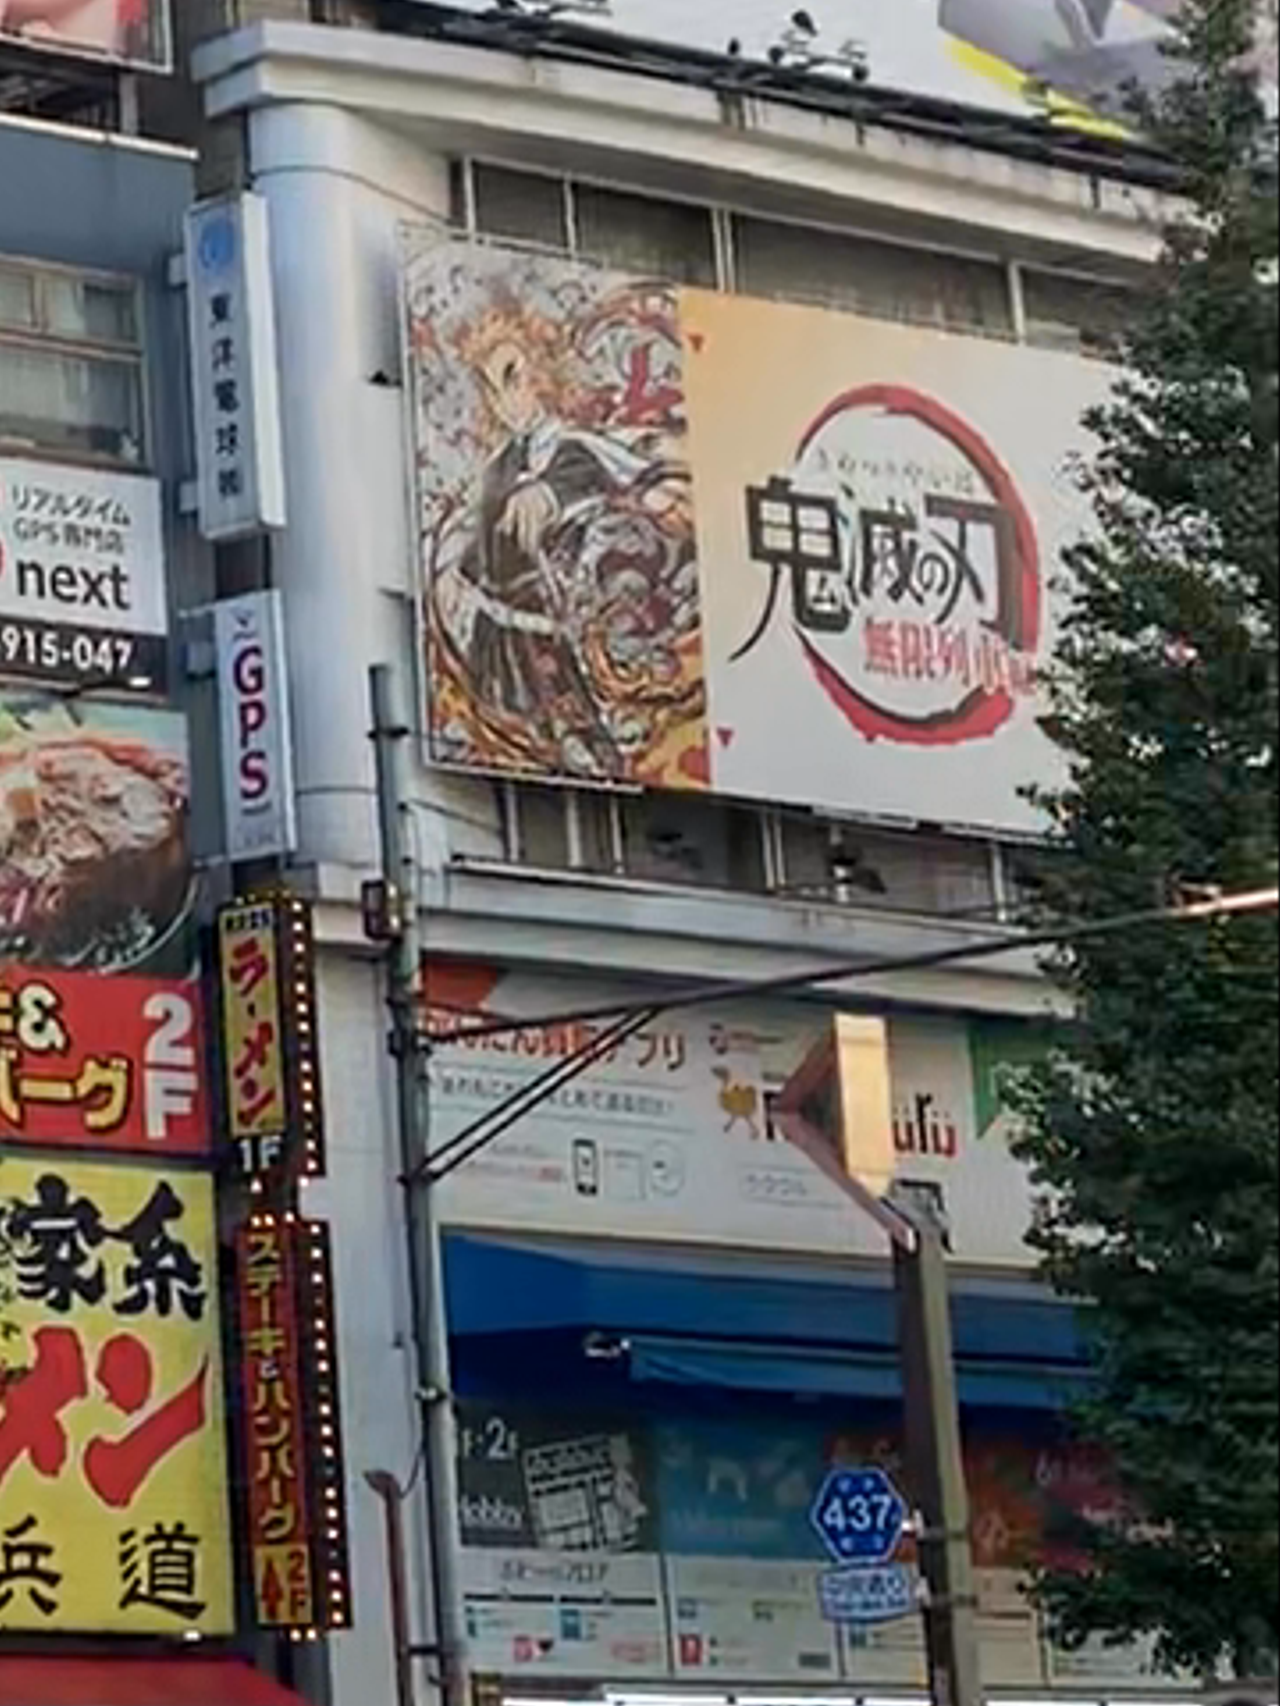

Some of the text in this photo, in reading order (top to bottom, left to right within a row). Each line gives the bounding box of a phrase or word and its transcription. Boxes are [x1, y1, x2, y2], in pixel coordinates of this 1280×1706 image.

[16, 559, 131, 611] next
[728, 475, 1024, 663] 鬼滅の刃
[232, 645, 268, 801] GPS
[142, 991, 199, 1140] 2F
[240, 1139, 280, 1172] 1F
[823, 1495, 892, 1531] 437
